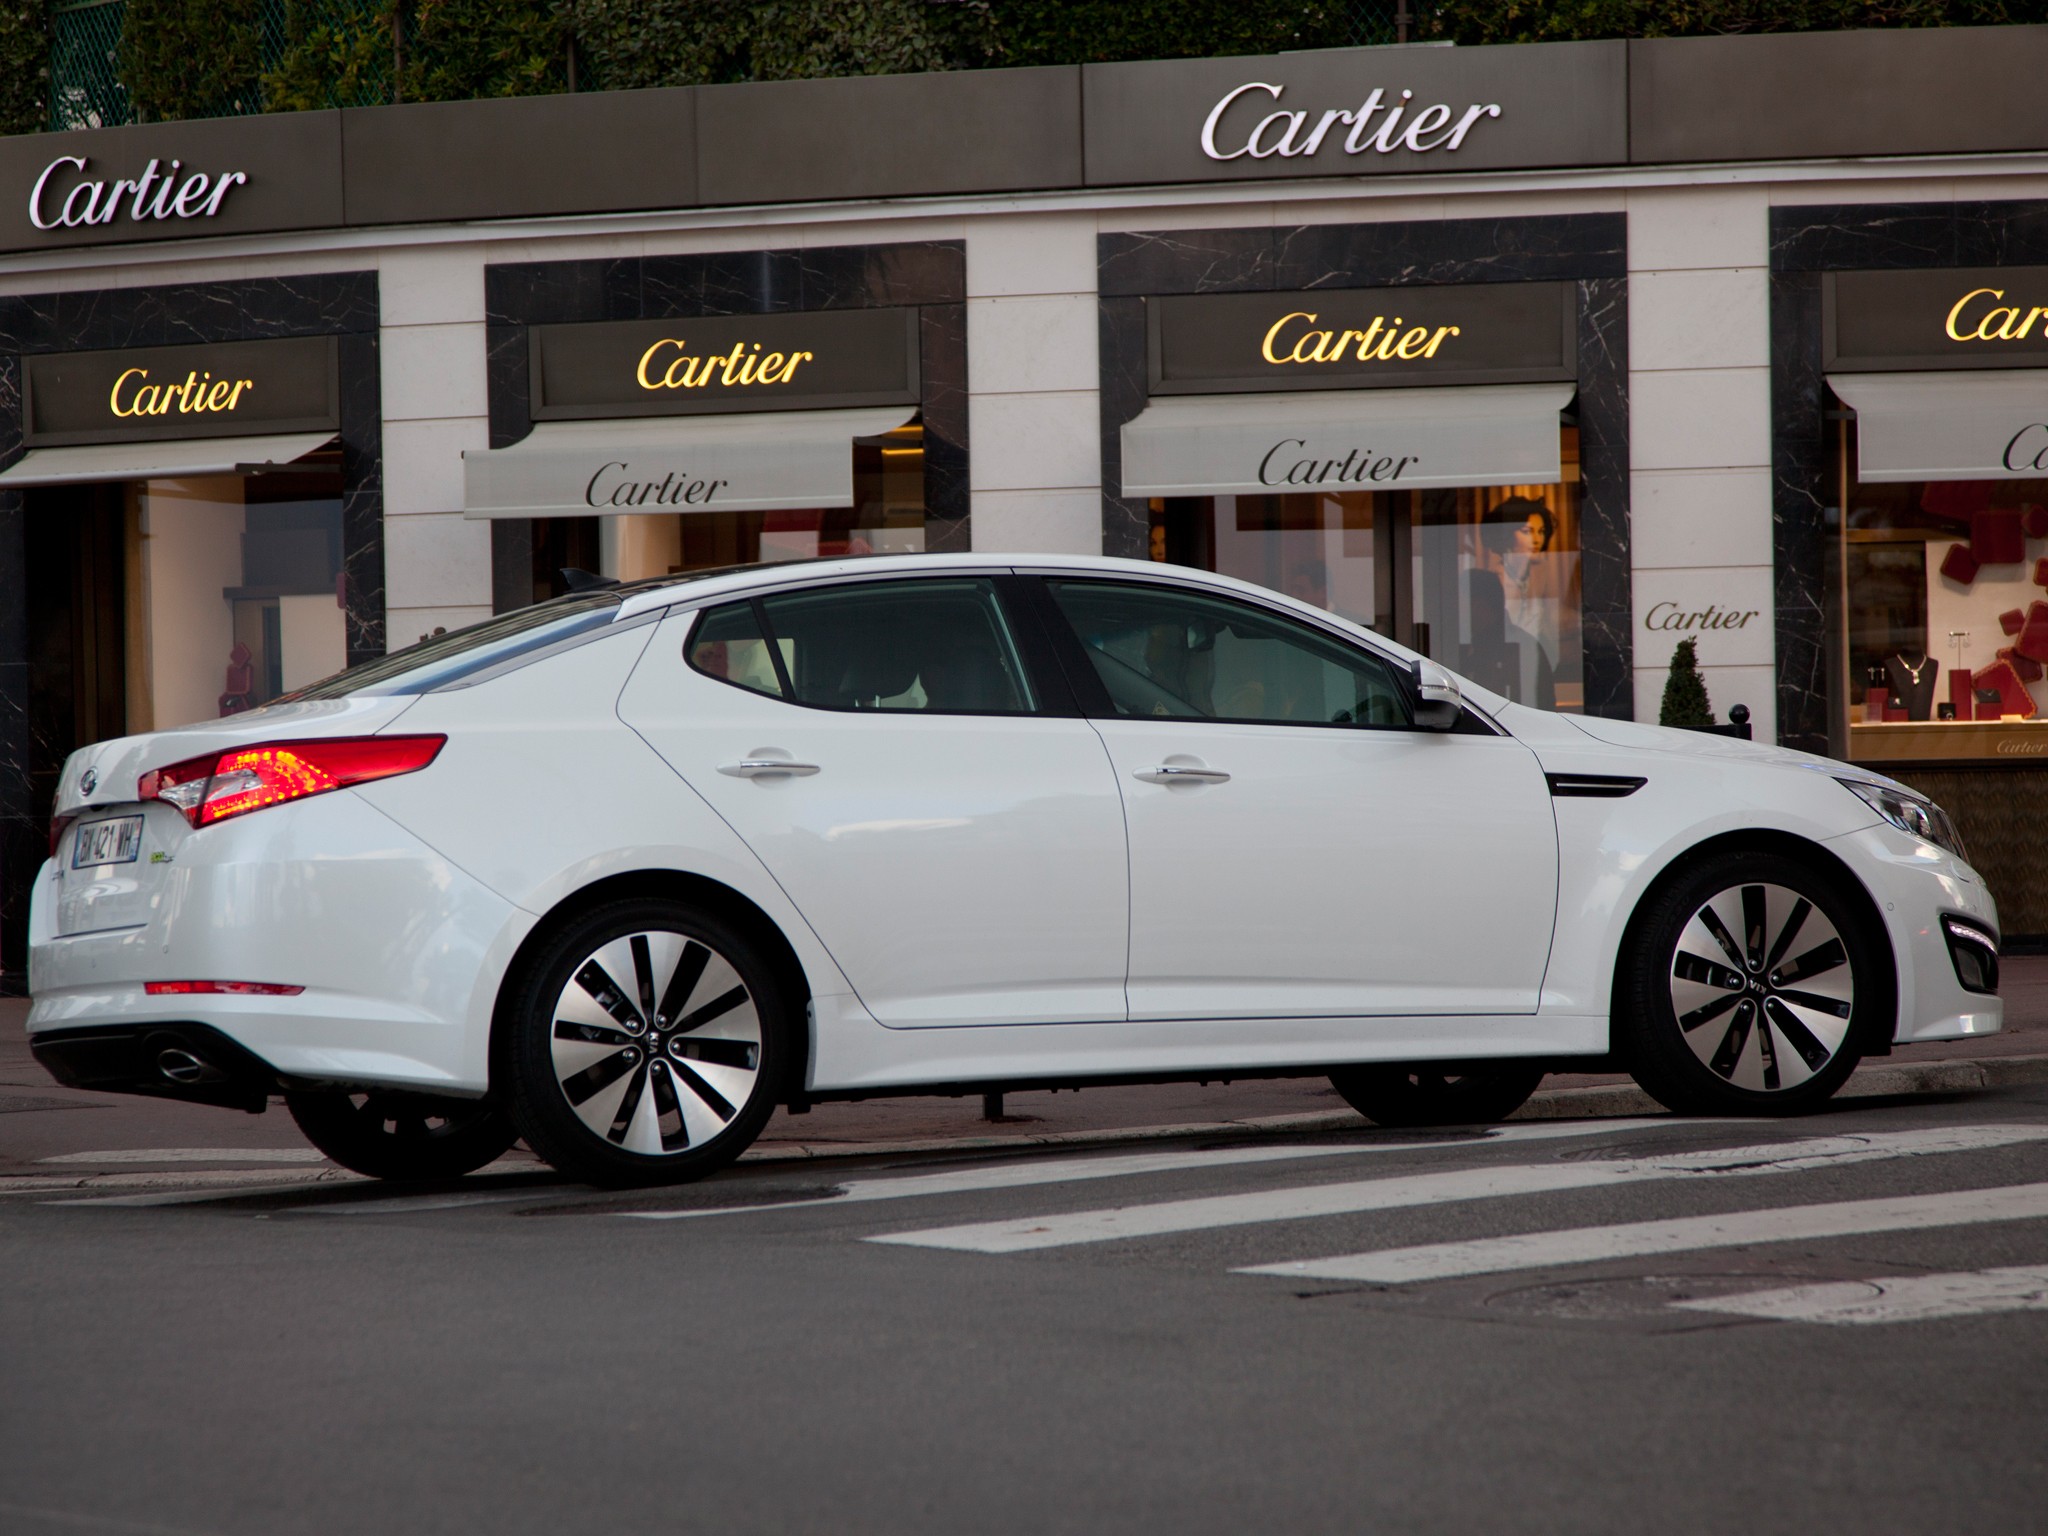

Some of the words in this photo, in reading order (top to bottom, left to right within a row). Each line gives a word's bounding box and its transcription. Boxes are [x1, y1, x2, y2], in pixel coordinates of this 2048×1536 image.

[1200, 82, 1501, 160] Cartier
[28, 156, 246, 230] Cartier
[1261, 312, 1460, 365] Cartier
[1945, 288, 2048, 342] Car
[636, 339, 813, 390] Cartier
[110, 368, 253, 418] Cartier
[586, 462, 728, 508] Cartier
[1258, 438, 1418, 487] Cartier
[1645, 602, 1760, 631] Cartier
[1996, 740, 2048, 754] Cartier
